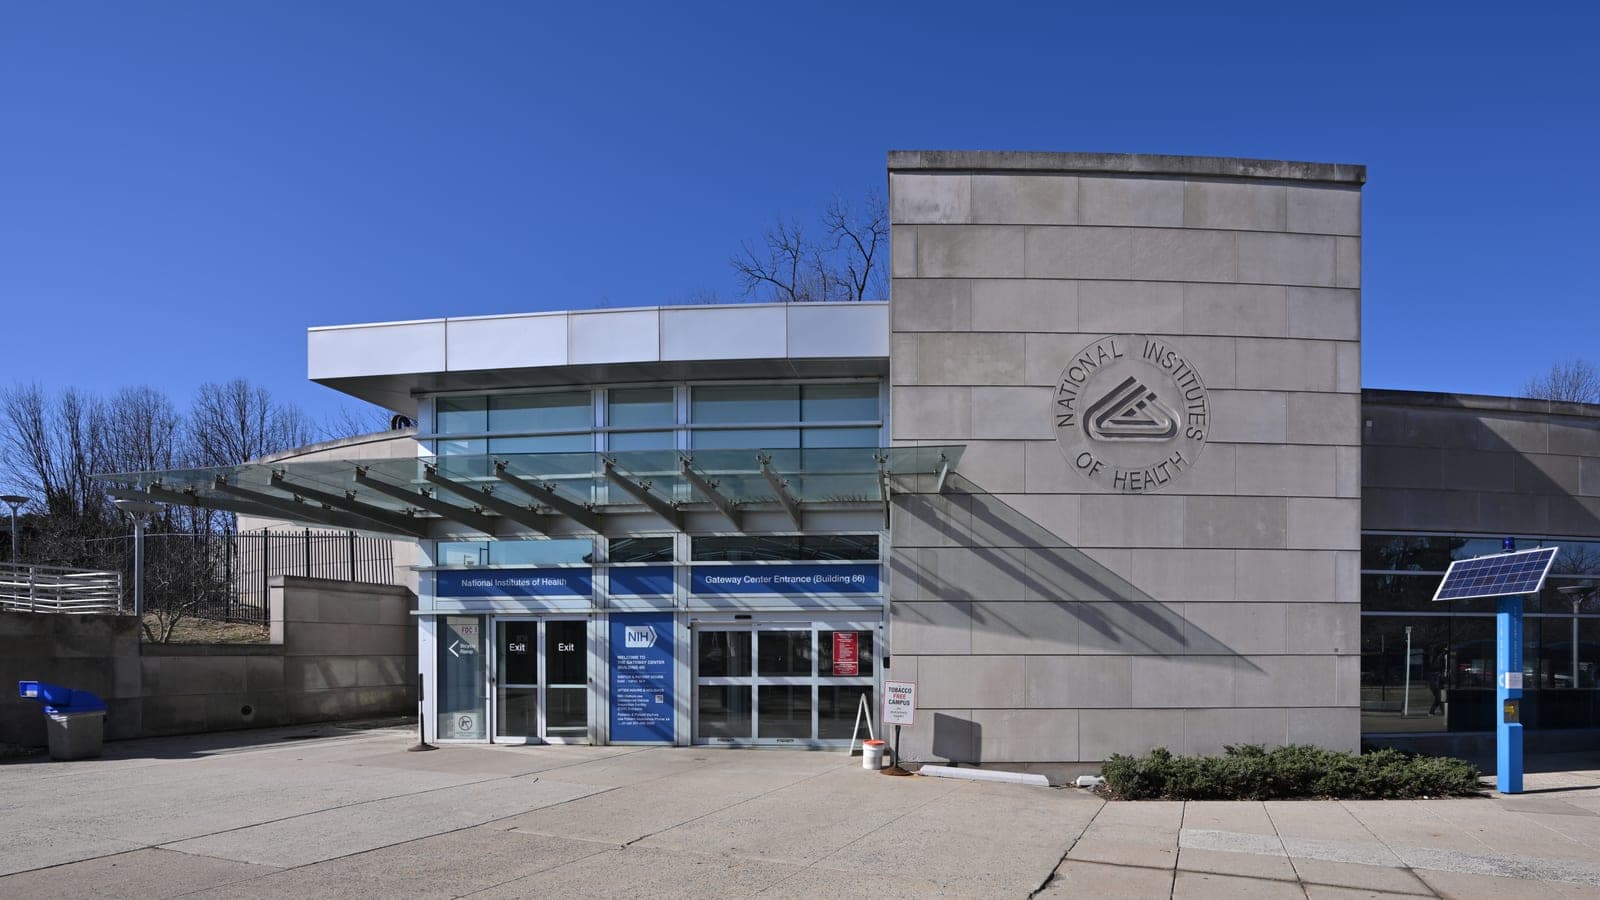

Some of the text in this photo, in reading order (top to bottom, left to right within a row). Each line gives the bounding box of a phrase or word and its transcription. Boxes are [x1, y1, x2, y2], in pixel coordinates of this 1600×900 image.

[1056, 340, 1206, 441] NATIONAL INSTITUTES
[1076, 451, 1189, 490] OF HEALTH
[461, 577, 567, 587] National Institutes of Health
[705, 574, 866, 585] Gateway Center Entrance (Building 66)
[628, 631, 649, 642] NIH
[509, 643, 525, 652] Exit
[558, 643, 575, 652] Exit
[888, 686, 913, 694] TOBACCO
